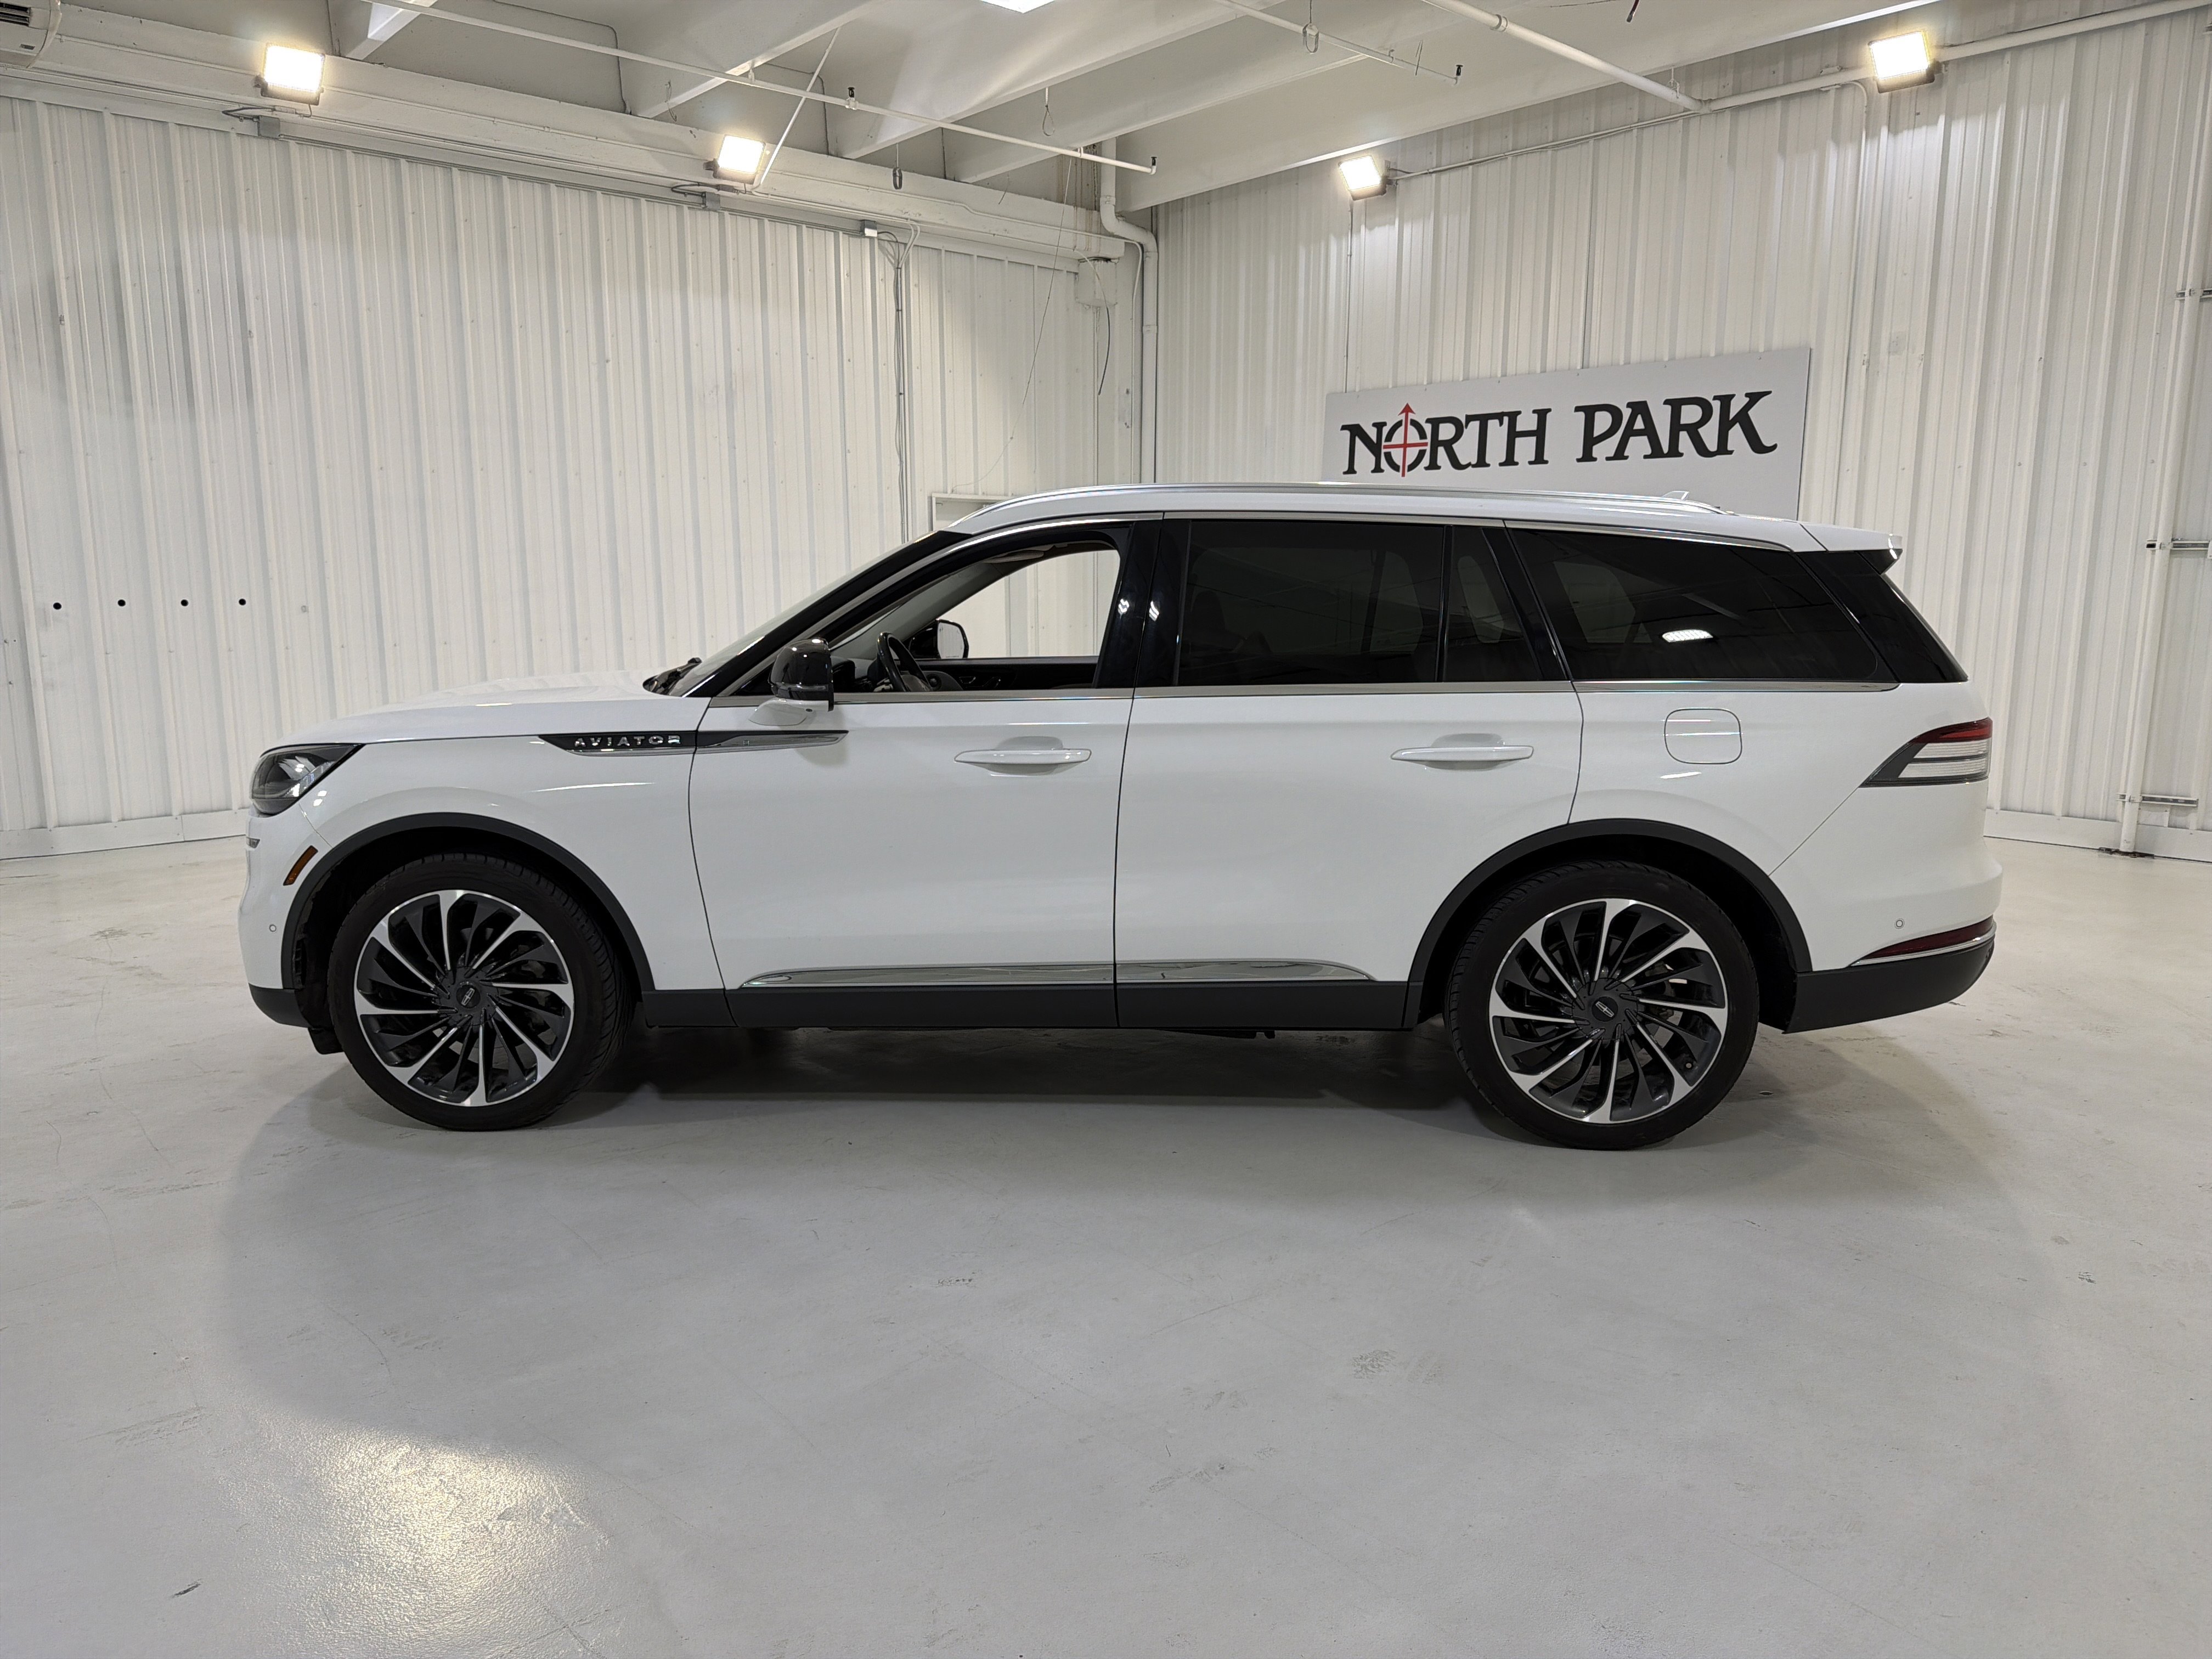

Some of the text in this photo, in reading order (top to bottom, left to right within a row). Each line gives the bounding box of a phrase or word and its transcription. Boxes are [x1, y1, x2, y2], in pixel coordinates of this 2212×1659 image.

[1340, 391, 1778, 476] NORTH PARK
[575, 735, 681, 747] AVIATOR
